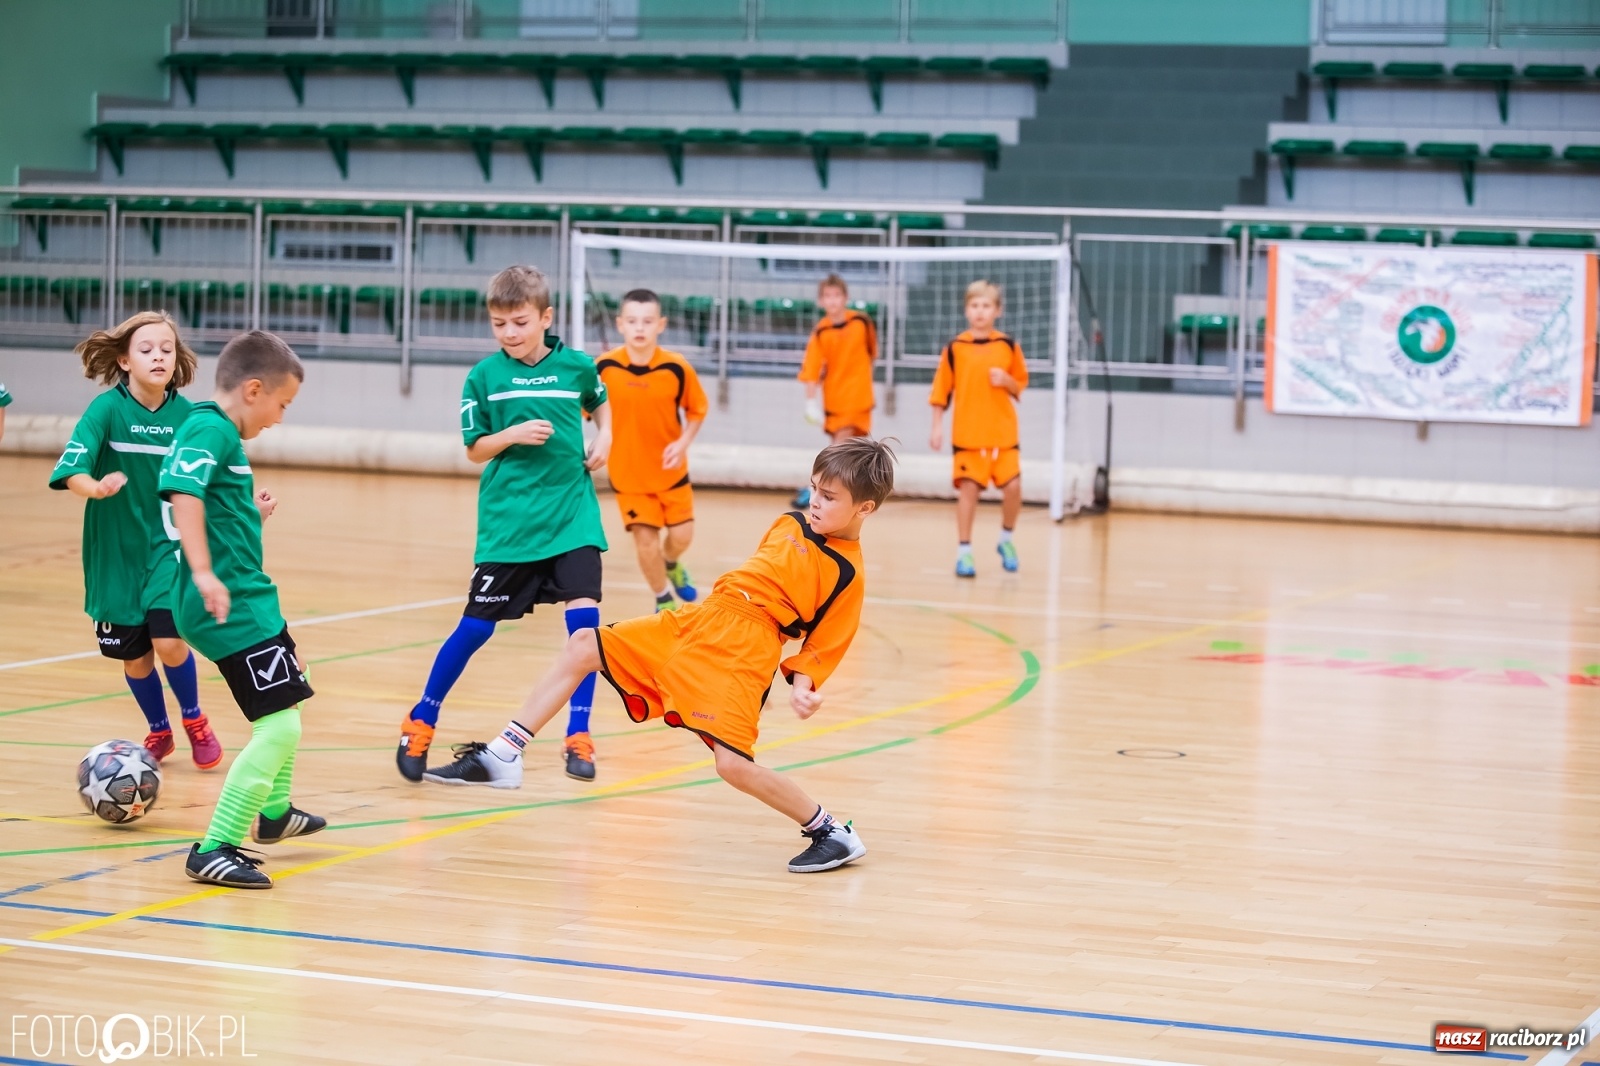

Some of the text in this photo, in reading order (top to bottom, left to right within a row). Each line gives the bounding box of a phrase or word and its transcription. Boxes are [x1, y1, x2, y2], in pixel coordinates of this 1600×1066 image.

[512, 375, 558, 385] GIVOVA
[131, 424, 173, 434] GIVOVA
[480, 575, 494, 592] 7
[475, 595, 509, 603] GIVOVA
[97, 637, 121, 646] VOVA
